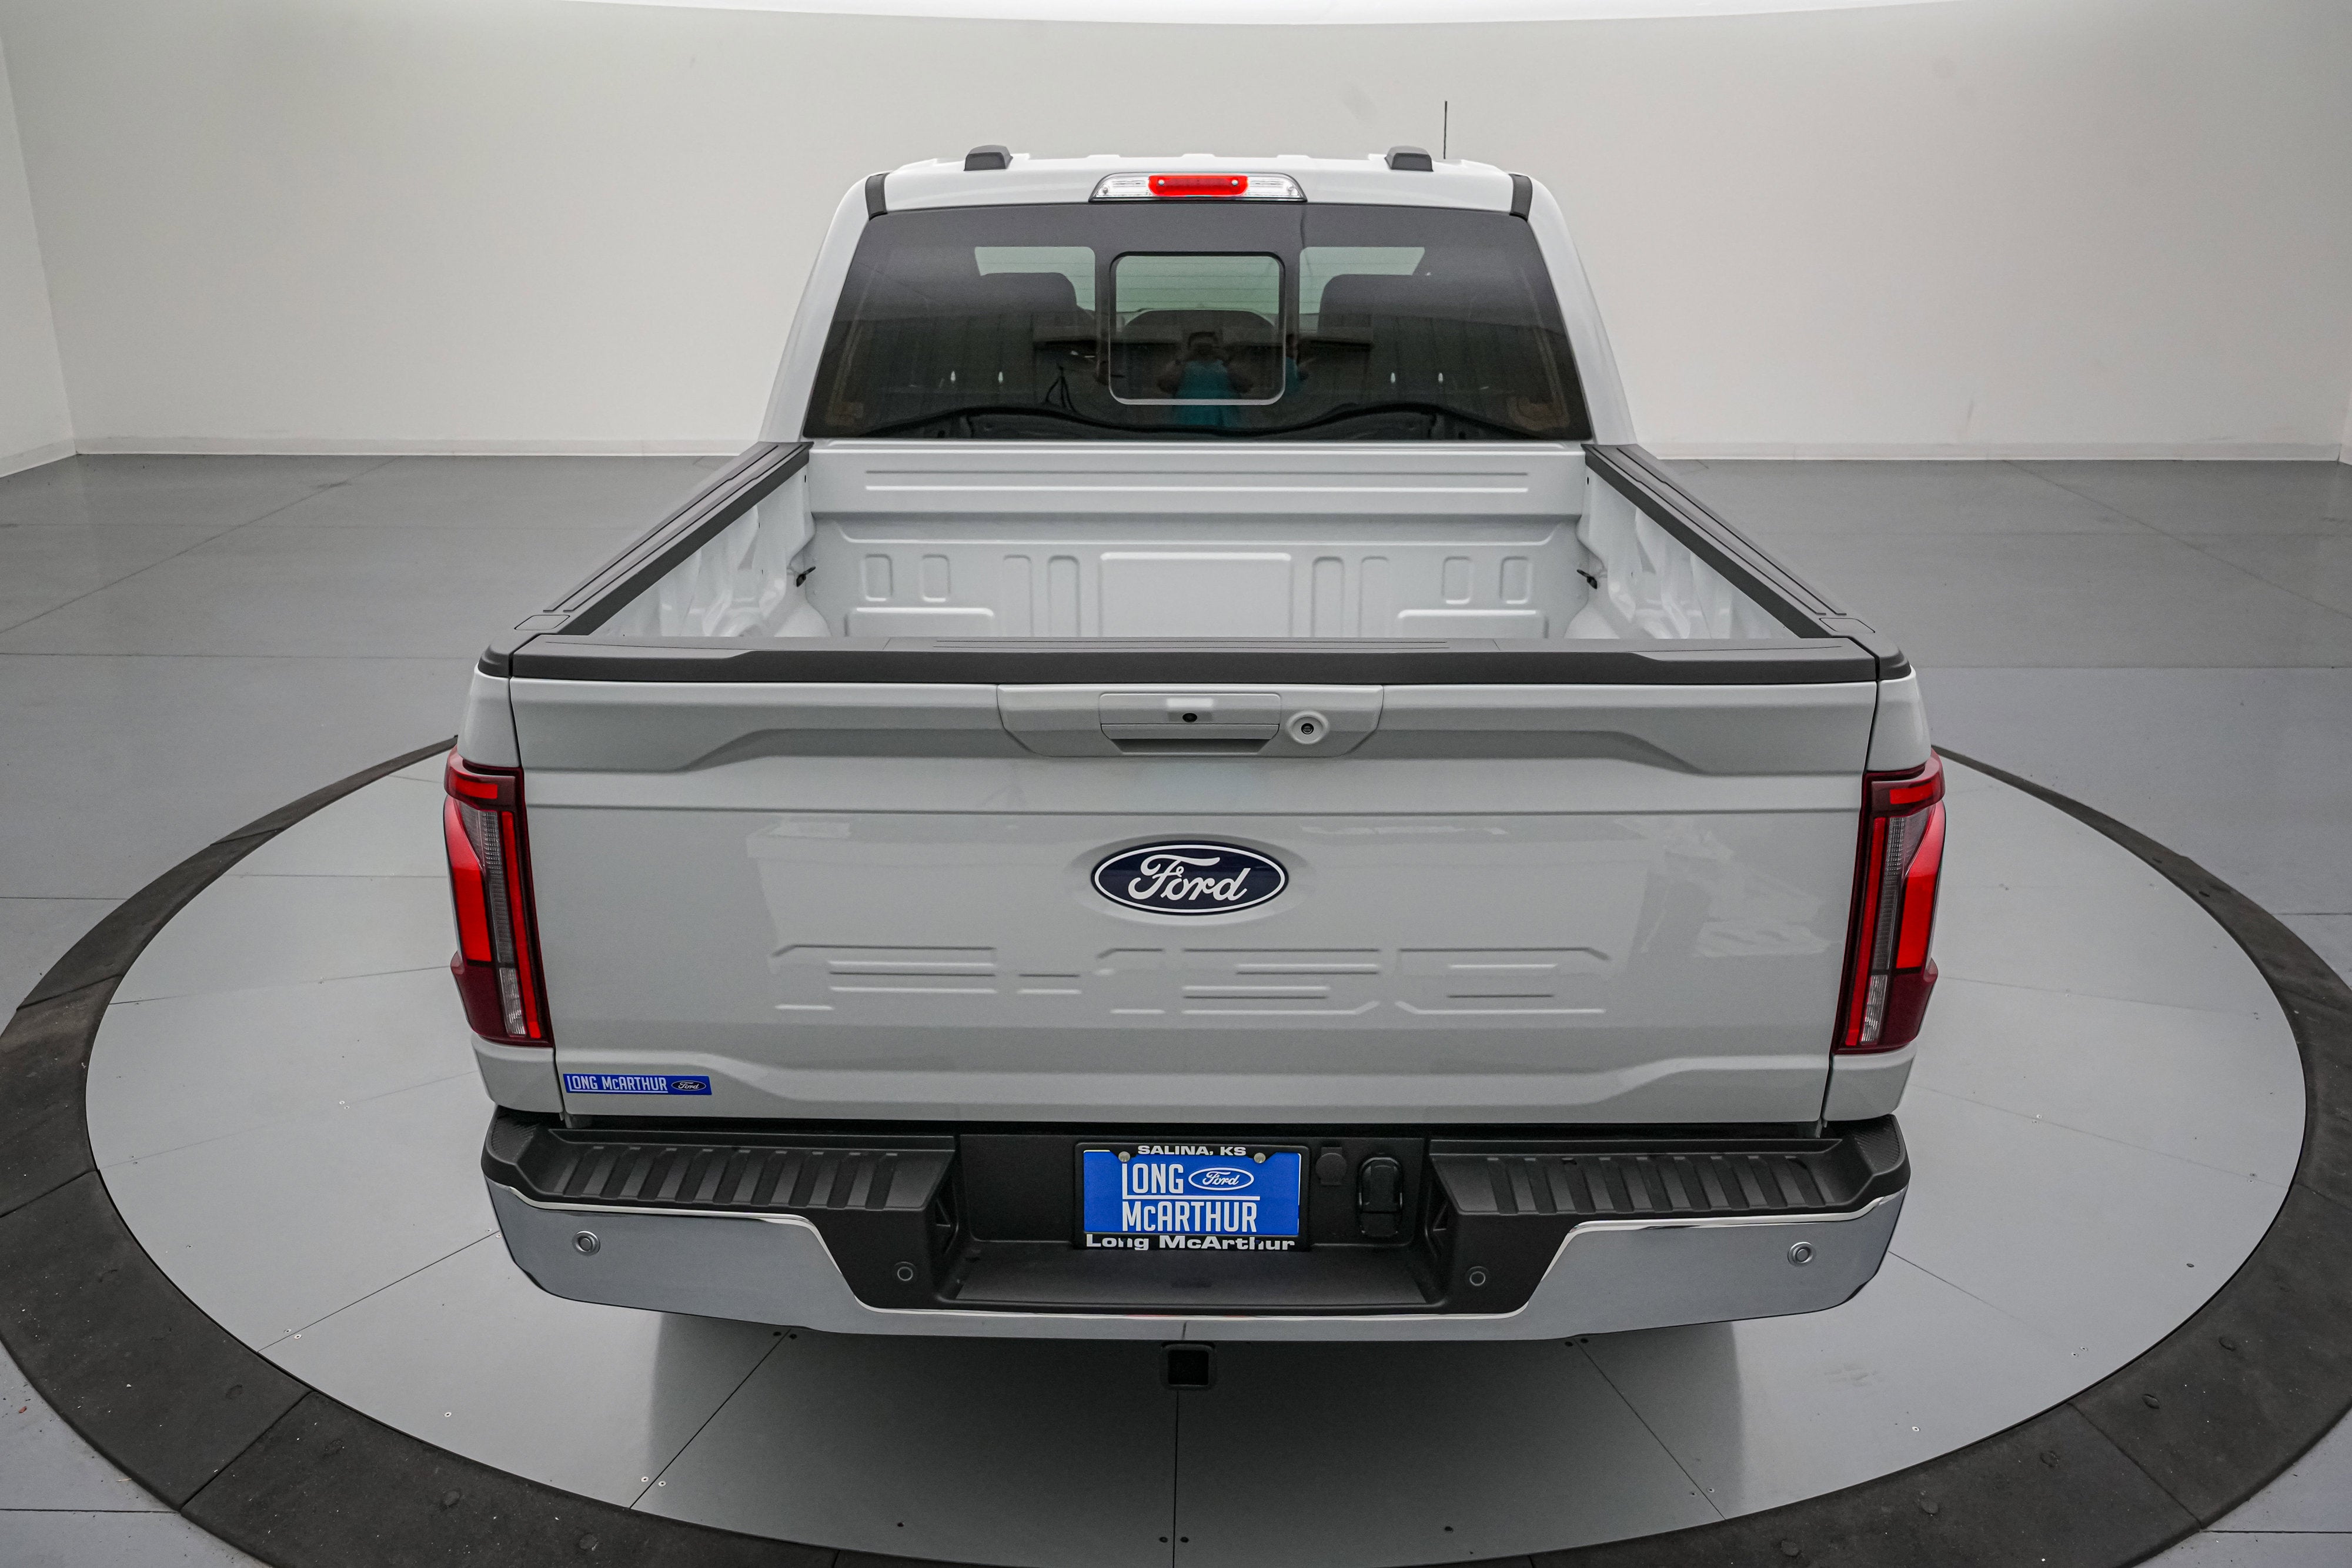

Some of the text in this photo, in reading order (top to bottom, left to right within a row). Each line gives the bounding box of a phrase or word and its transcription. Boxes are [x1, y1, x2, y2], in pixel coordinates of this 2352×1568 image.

[1128, 854, 1251, 901] Ford
[769, 942, 1611, 1015] F-150
[566, 1075, 700, 1092] LONG McARTHUR Ford
[1137, 1144, 1247, 1156] SALINA, KS
[1122, 1163, 1184, 1195] LONG
[1202, 1171, 1239, 1186] Ford
[1121, 1202, 1257, 1232] McARTHUR
[1086, 1233, 1295, 1251] Long McArthur
